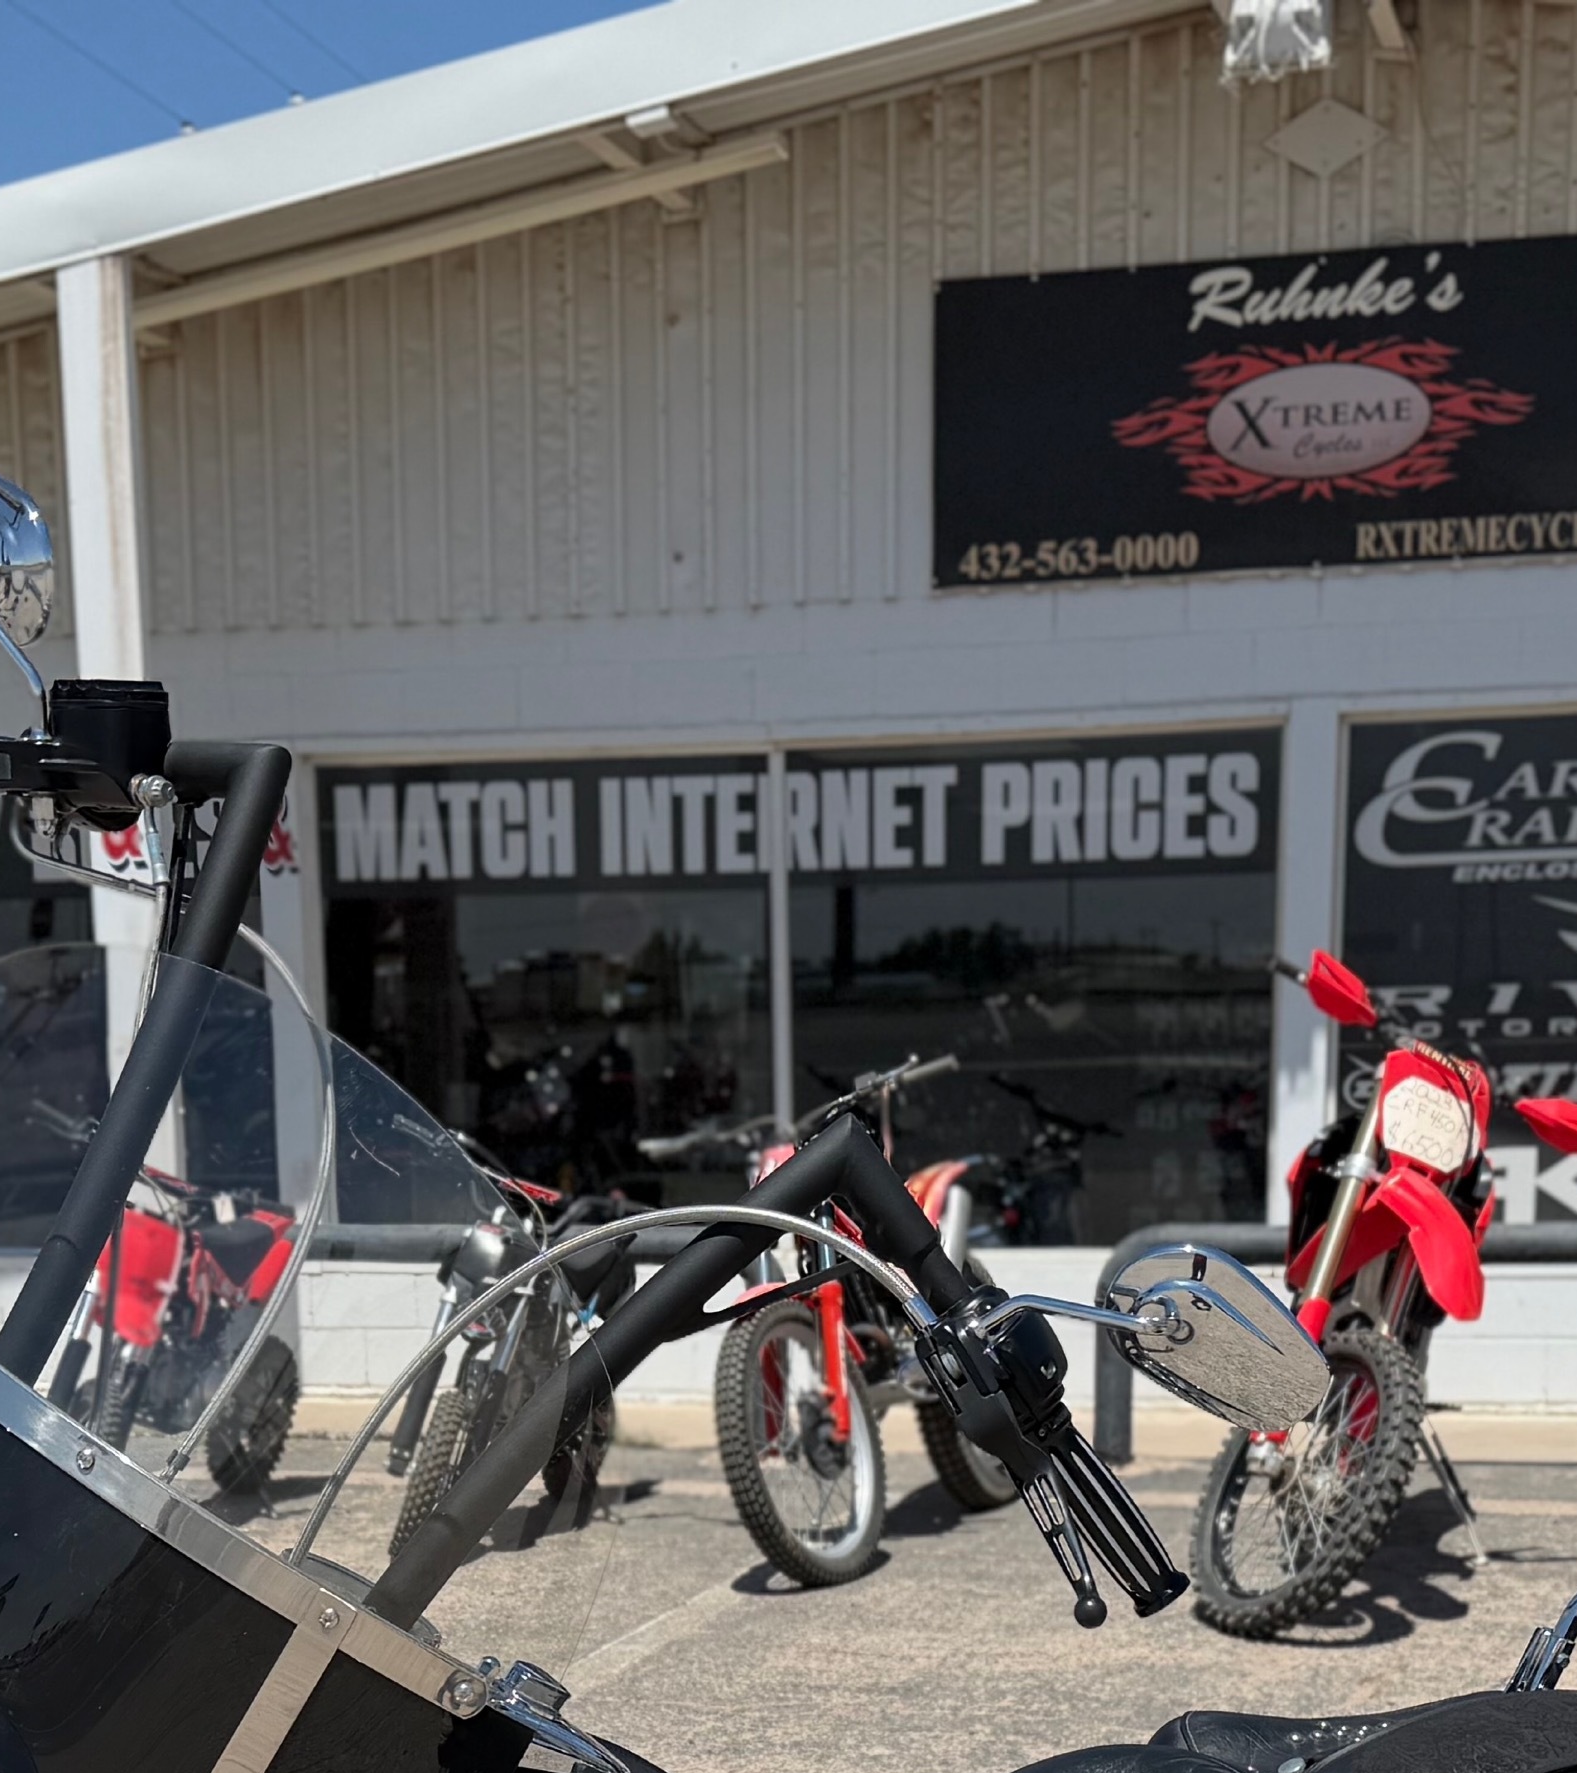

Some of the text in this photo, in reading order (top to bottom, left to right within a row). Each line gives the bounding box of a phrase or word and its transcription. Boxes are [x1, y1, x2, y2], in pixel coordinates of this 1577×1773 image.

[1187, 251, 1464, 332] Ruhnke's
[1231, 395, 1413, 451] XTREME
[958, 531, 1200, 580] 432-563-0000
[333, 778, 577, 882] MATCH
[599, 764, 959, 877] INTERNET
[981, 752, 1260, 866] PRICES
